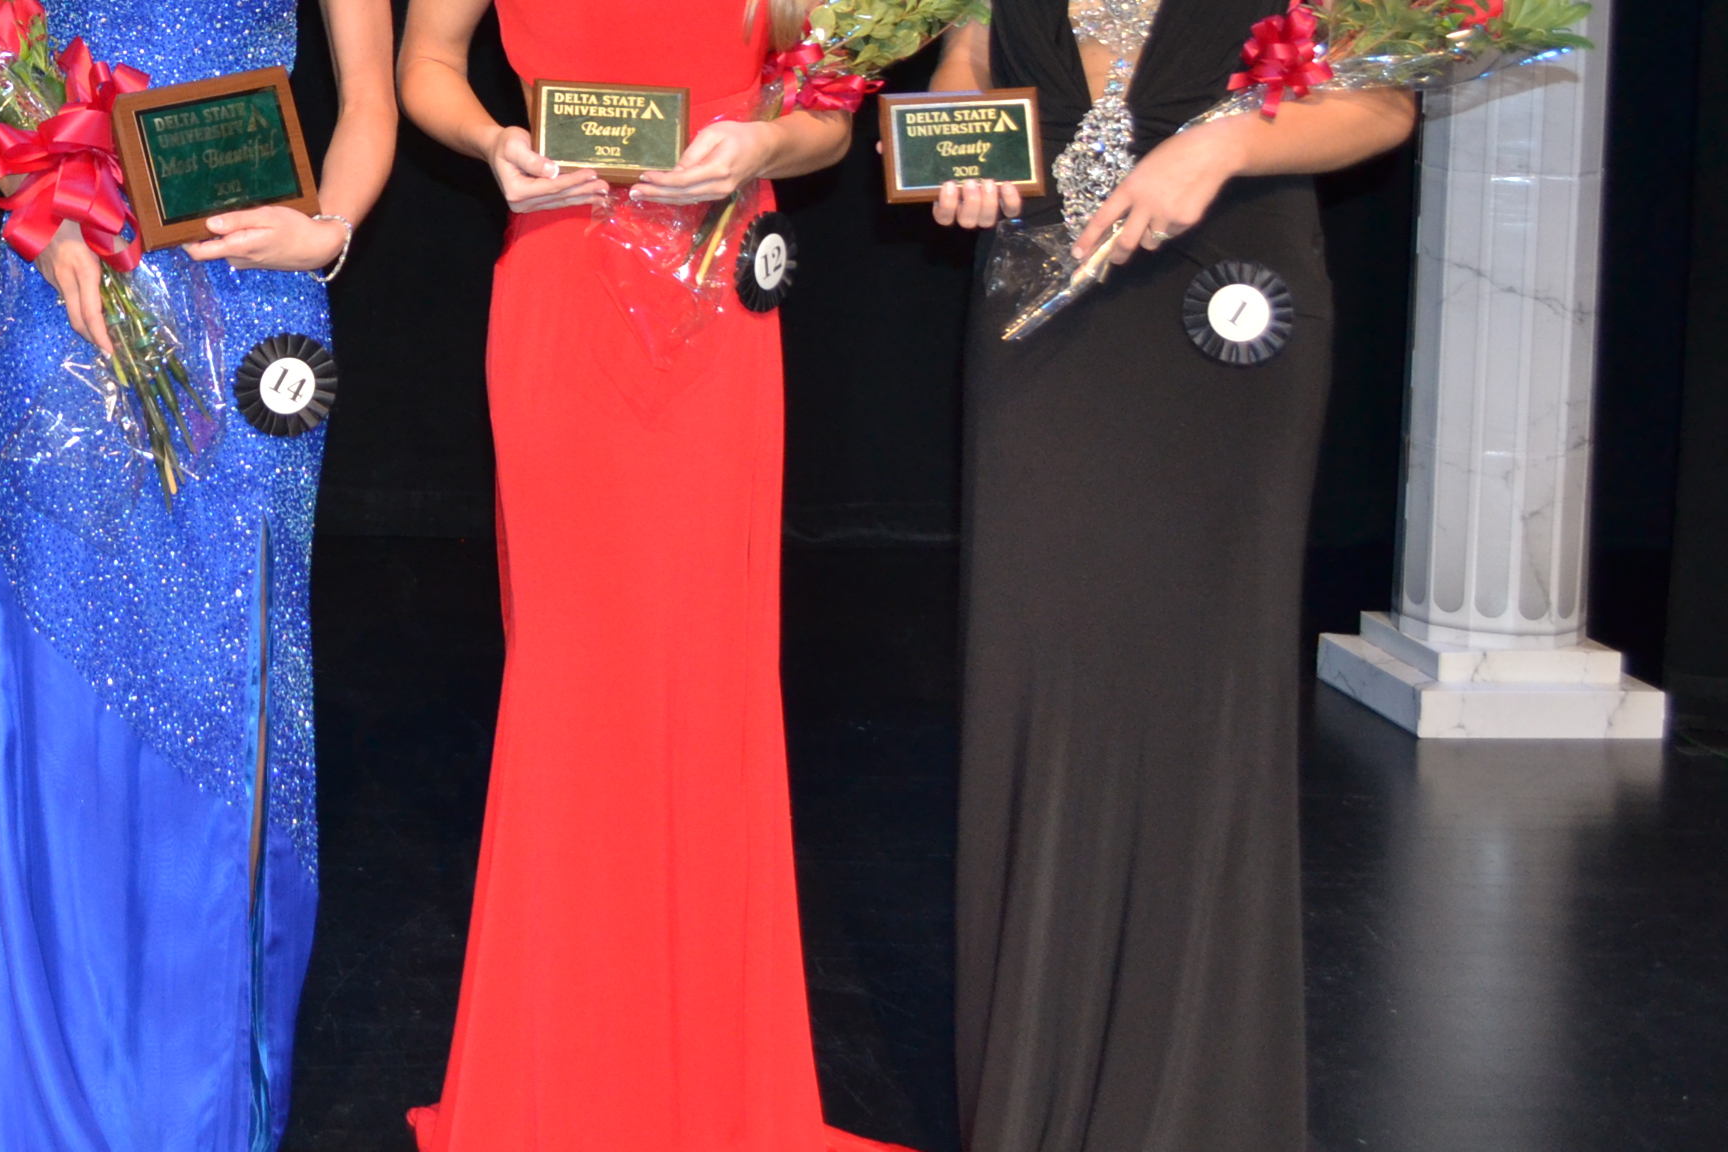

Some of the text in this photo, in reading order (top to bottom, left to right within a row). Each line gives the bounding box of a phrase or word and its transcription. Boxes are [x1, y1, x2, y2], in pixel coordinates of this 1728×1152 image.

[553, 104, 640, 119] UNIVERSITY
[554, 92, 646, 107] DELTA STATE
[153, 102, 247, 132] DELTA STATE
[905, 108, 997, 124] DELTA STATE
[157, 119, 245, 148] UNIVERSITY
[581, 121, 636, 145] Beauty
[906, 121, 993, 137] UNIVERSITY
[157, 128, 278, 178] Most Beautiful
[594, 145, 621, 157] 2012
[936, 139, 992, 163] Beauty
[952, 165, 980, 177] 2012
[214, 179, 242, 196] 2012
[760, 245, 782, 280] 12
[1225, 298, 1248, 326] 1
[268, 365, 307, 403] 14
